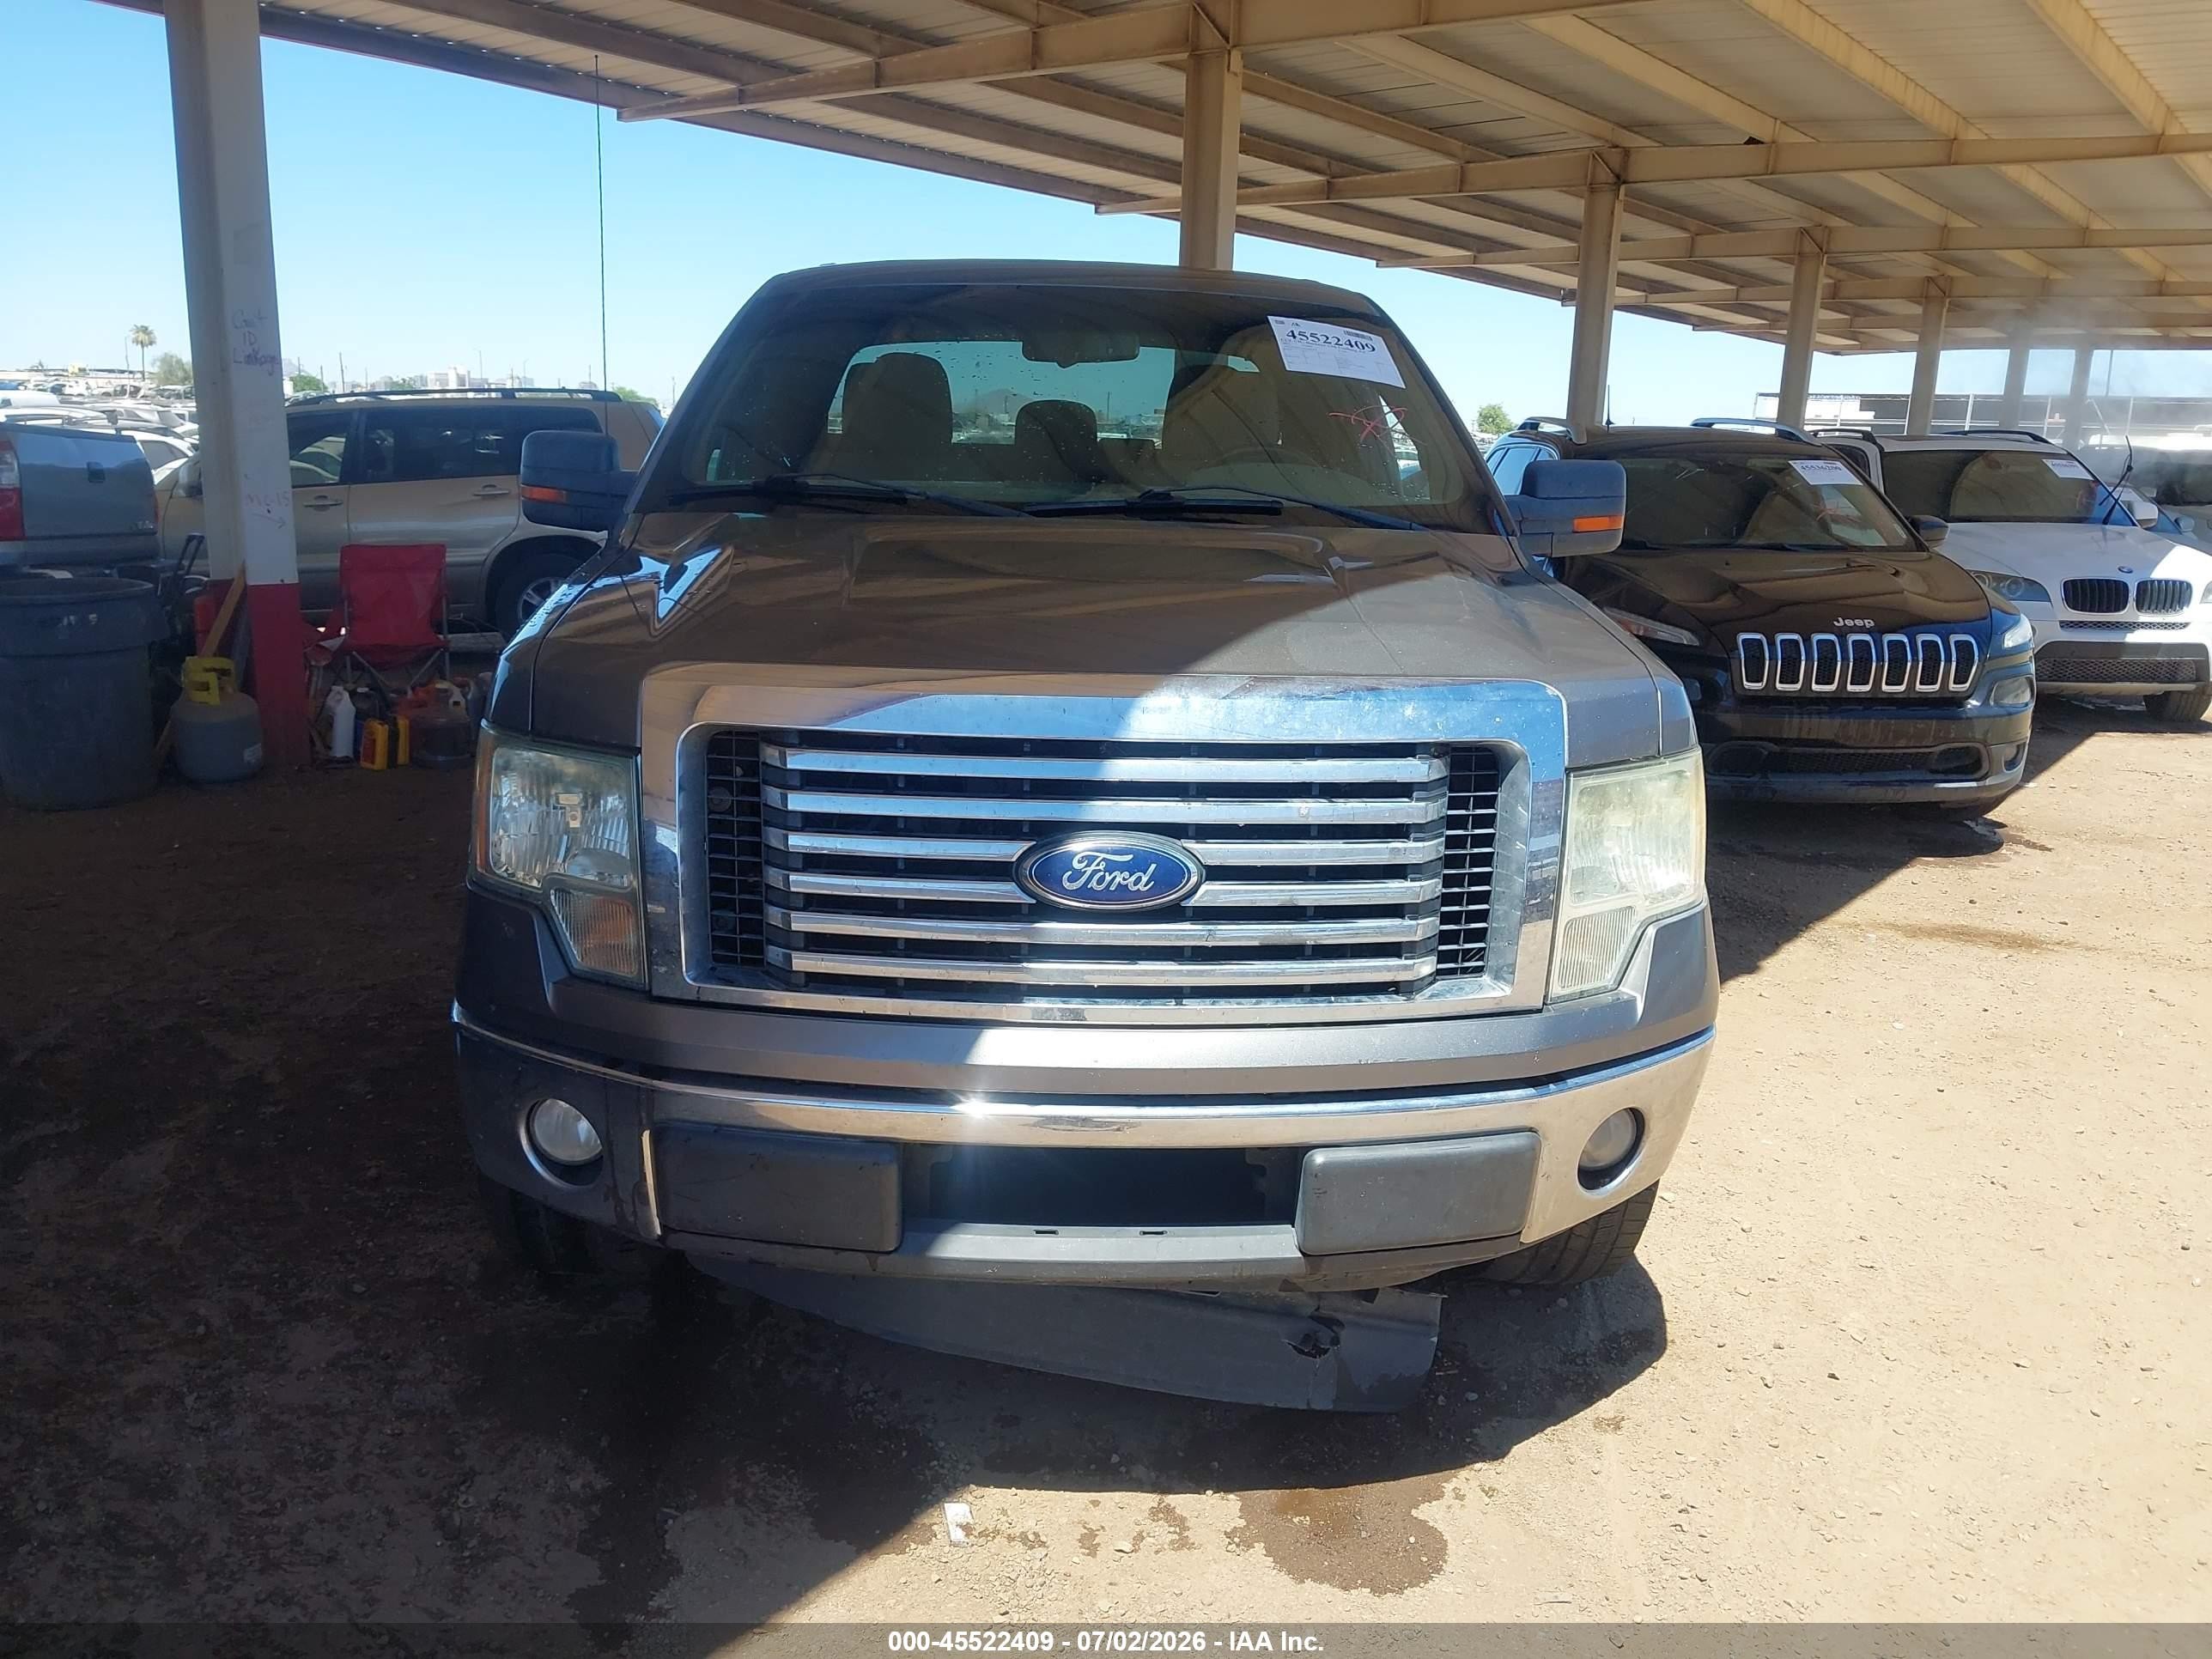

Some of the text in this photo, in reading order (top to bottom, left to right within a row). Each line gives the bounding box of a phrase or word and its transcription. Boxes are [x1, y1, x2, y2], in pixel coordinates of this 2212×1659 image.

[1285, 329, 1376, 353] 45522409
[1833, 617, 1875, 628] Jeep
[1062, 851, 1157, 891] Ford
